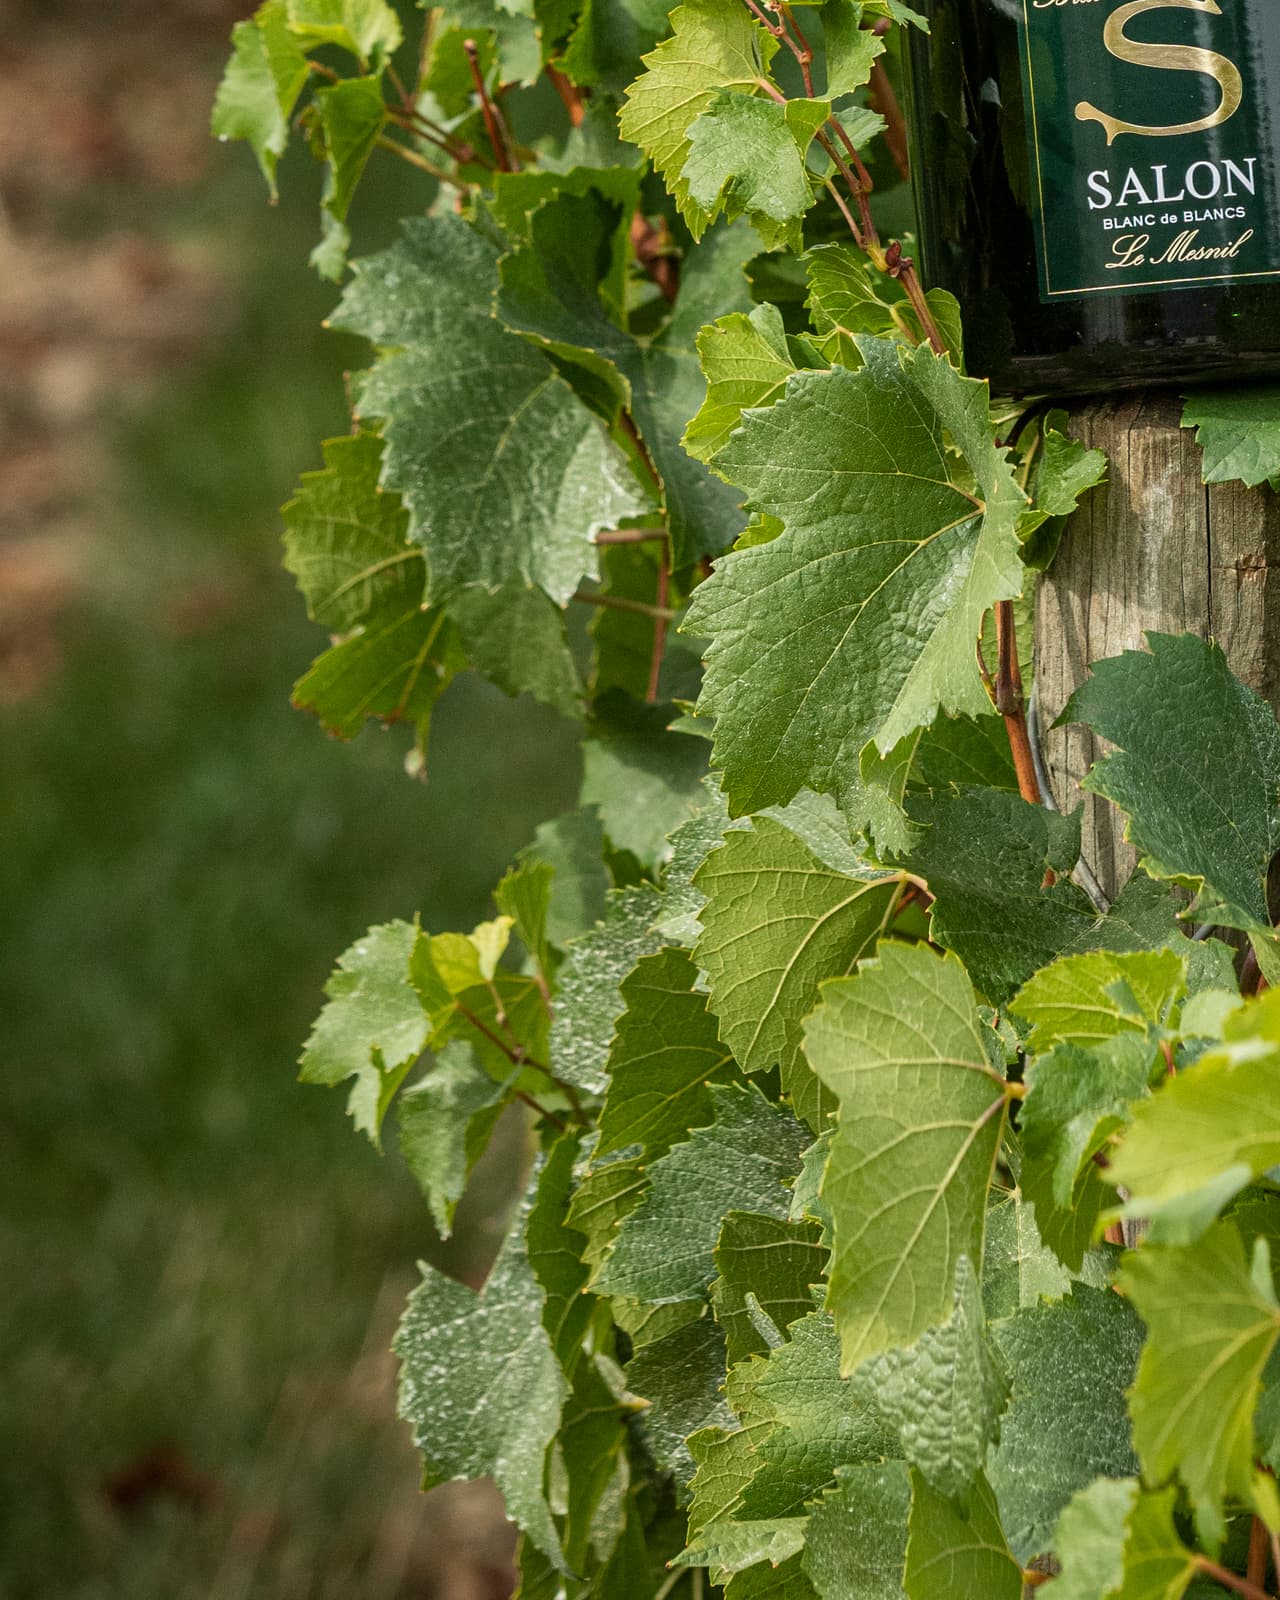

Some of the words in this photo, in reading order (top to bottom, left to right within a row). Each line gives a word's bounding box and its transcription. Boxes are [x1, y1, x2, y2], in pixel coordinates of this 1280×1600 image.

[1086, 157, 1257, 211] SALON
[1102, 212, 1156, 231] BLANC
[1160, 212, 1178, 225] de
[1183, 206, 1246, 223] BLANCS
[1105, 233, 1150, 271] Le
[1149, 228, 1254, 266] Mesnil
